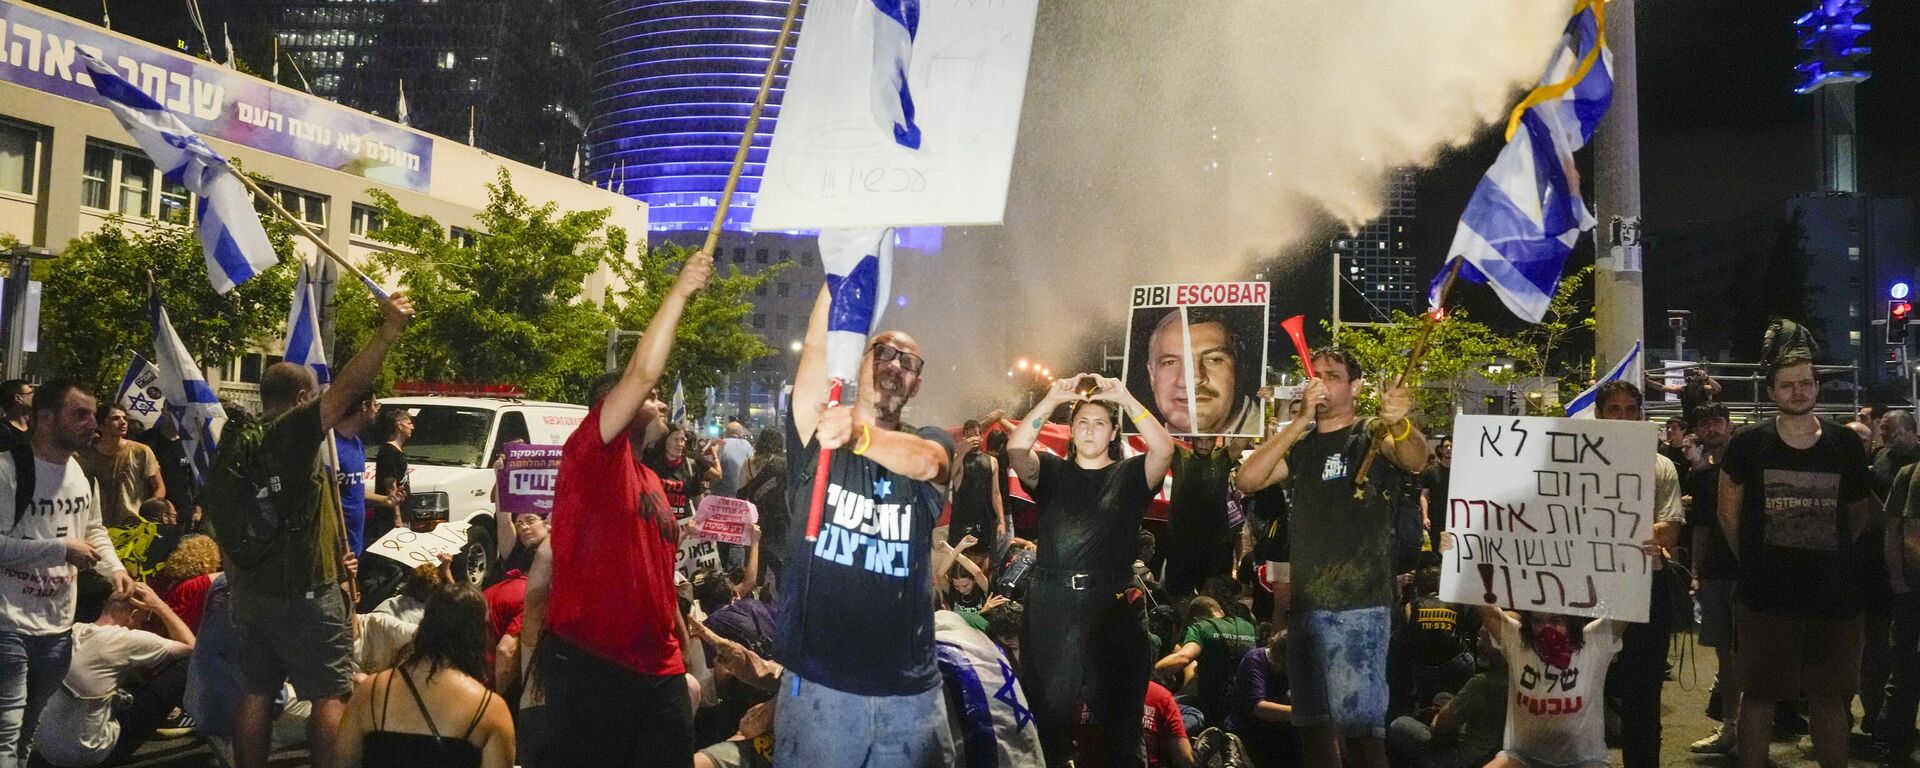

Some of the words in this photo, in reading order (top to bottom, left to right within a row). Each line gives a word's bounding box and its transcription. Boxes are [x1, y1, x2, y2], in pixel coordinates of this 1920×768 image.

[118, 56, 225, 121] שבחר
[237, 102, 283, 132] העם
[287, 117, 331, 145] נוצח
[336, 131, 361, 153] לא
[1133, 286, 1170, 307] BIBI
[1176, 283, 1267, 305] ESCOBAR
[1480, 419, 1528, 457] לא
[1545, 432, 1611, 466] אם
[510, 449, 545, 459] העסקה
[1533, 470, 1641, 506] תקום
[1450, 498, 1538, 533] אזרח
[1546, 502, 1640, 539] להיות
[700, 532, 718, 540] חיים
[721, 533, 742, 543] תציל
[814, 522, 910, 577] בארצנו
[1450, 532, 1508, 573] אותך
[1587, 541, 1646, 574] הם
[1520, 664, 1579, 693] שלום
[1516, 690, 1582, 716] עכשיו
